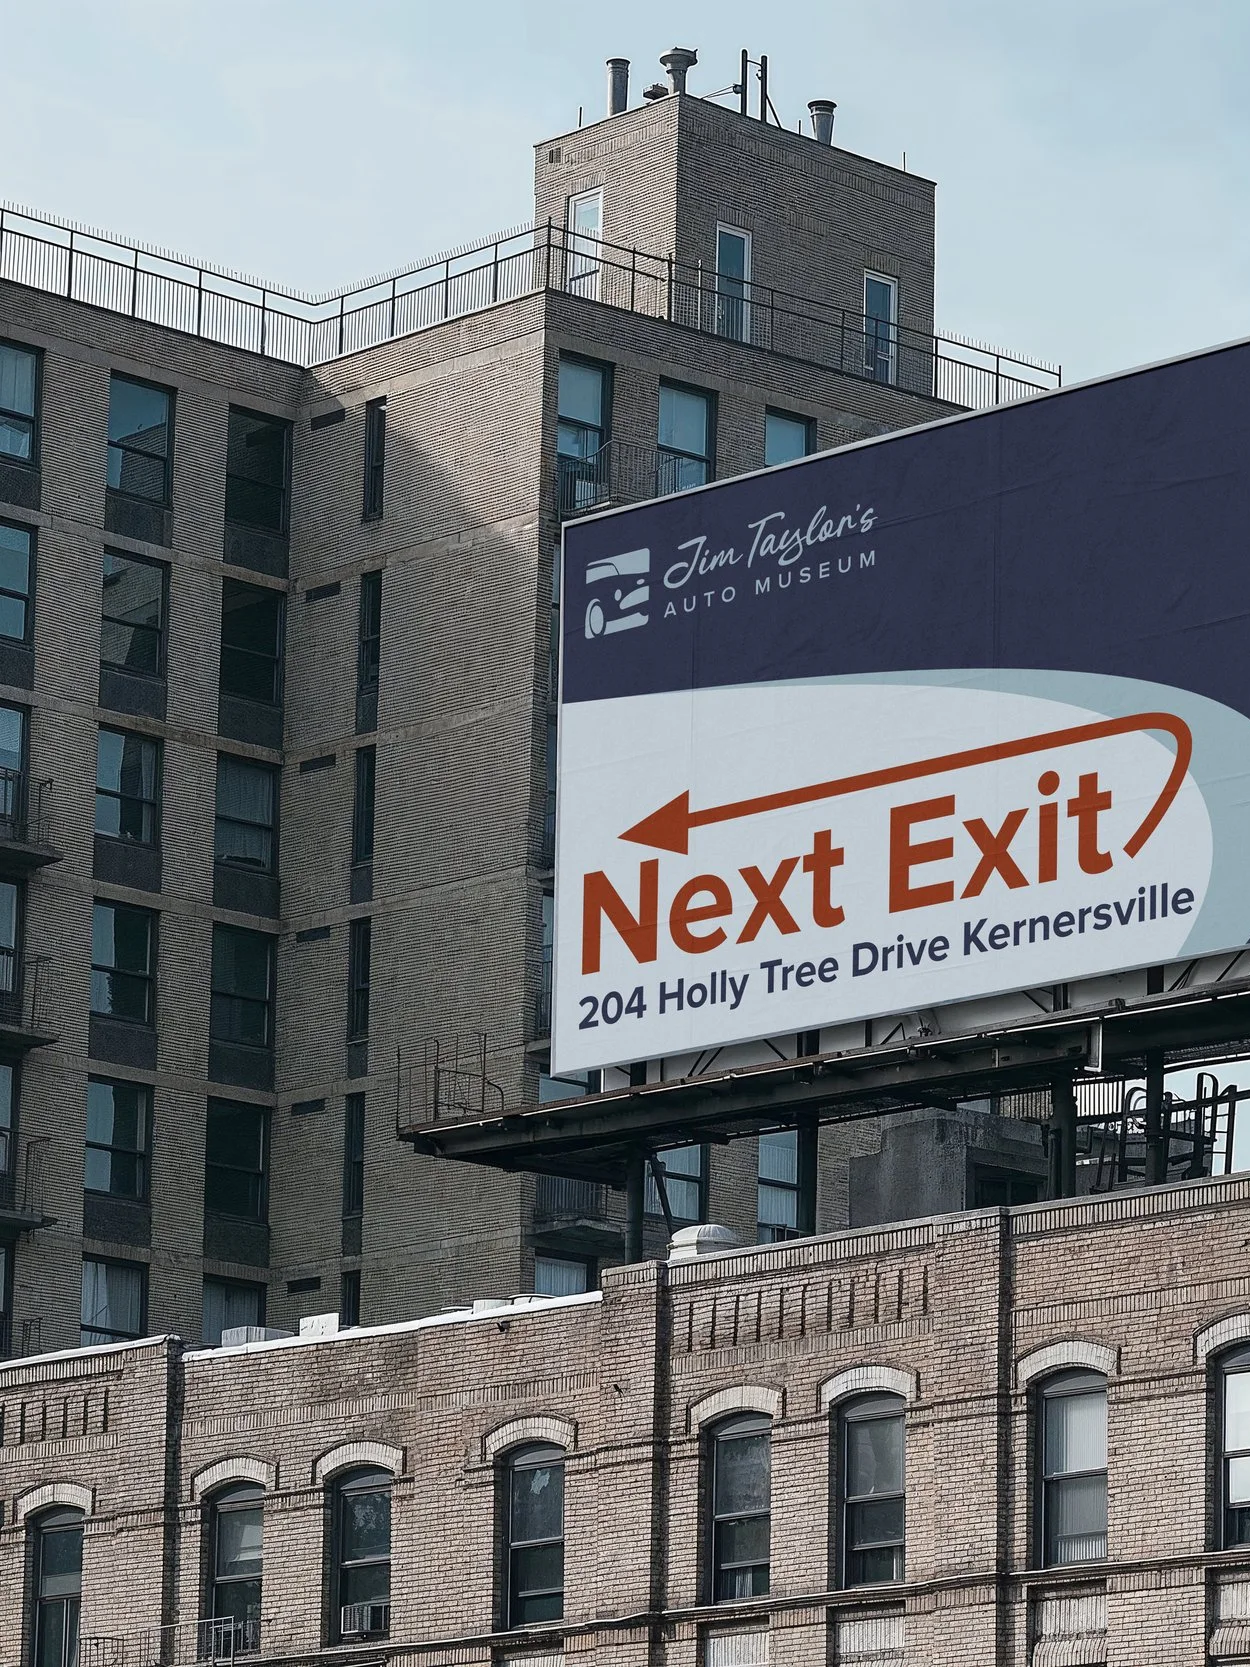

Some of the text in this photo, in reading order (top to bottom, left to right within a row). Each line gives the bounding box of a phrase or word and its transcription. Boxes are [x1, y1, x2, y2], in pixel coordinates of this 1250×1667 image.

[663, 503, 878, 589] Jim Taylor's
[663, 549, 876, 618] AUTO MUSEUM
[581, 770, 1114, 975] Next Exit
[578, 882, 1196, 1031] 204 Holly Tree Drive Kernersville
